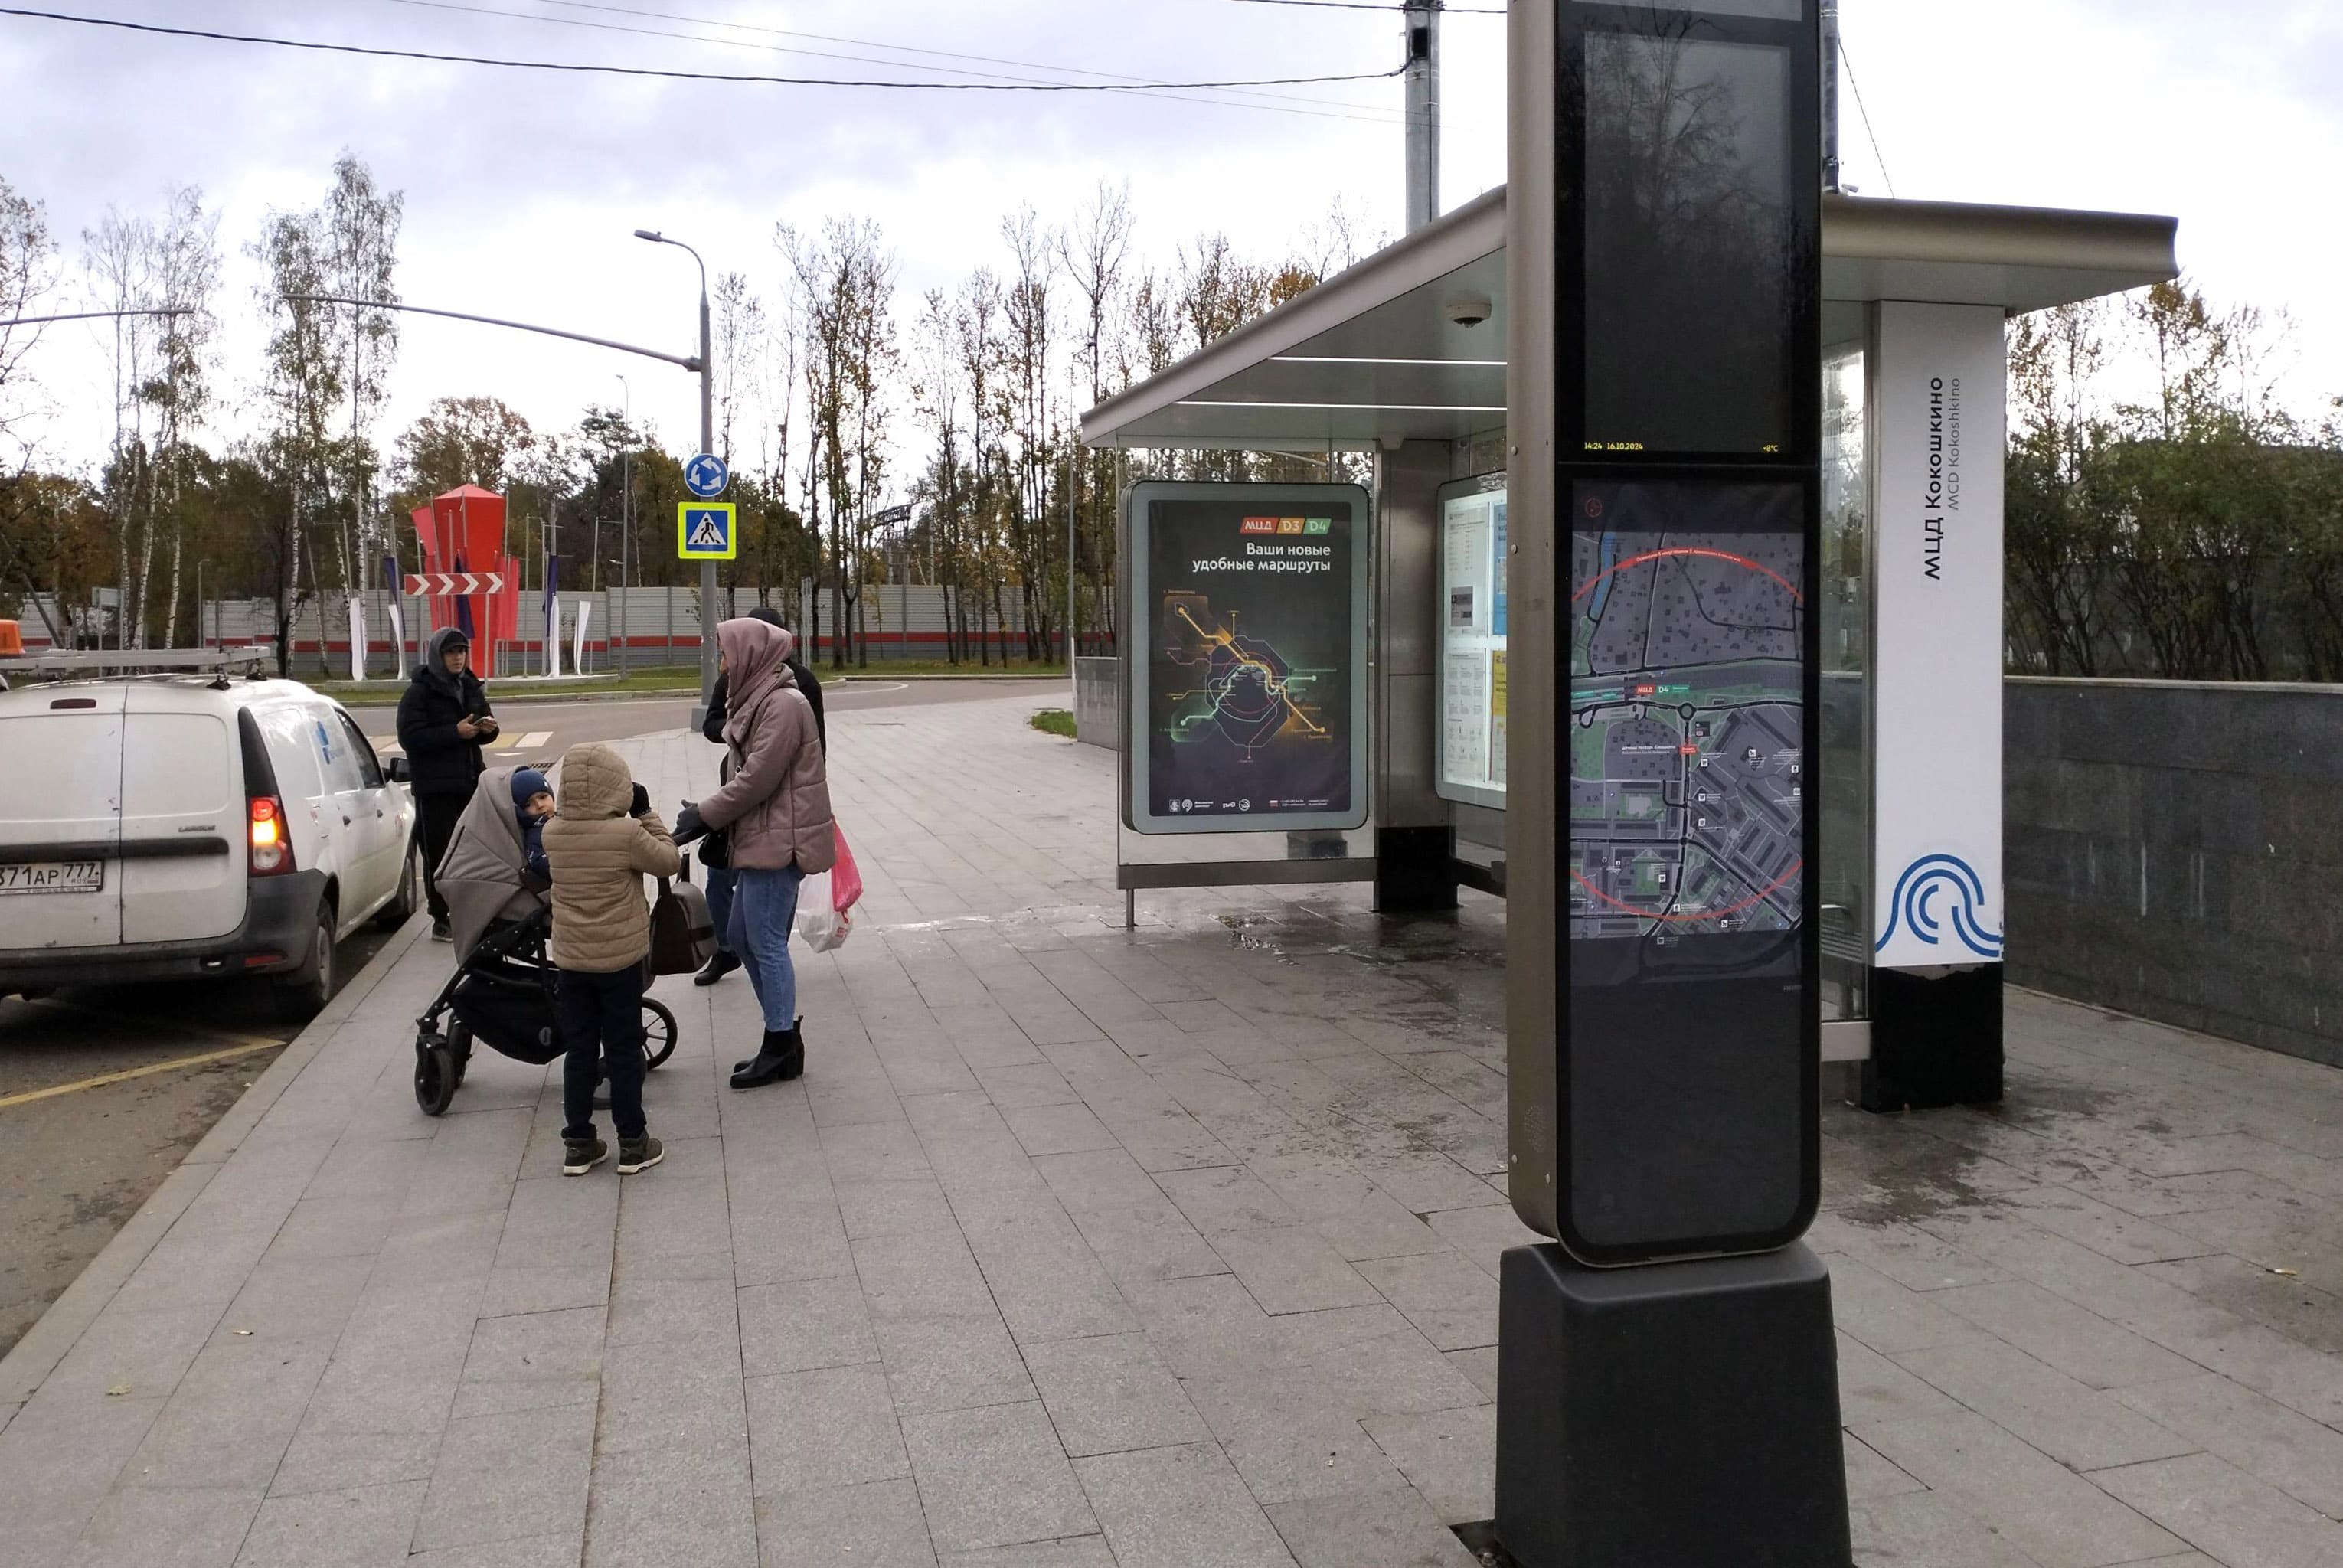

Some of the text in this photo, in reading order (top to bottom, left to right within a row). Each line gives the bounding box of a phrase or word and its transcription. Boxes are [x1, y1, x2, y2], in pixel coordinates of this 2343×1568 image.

[1584, 442, 1603, 450] 14:24
[1947, 377, 1960, 511] MCD Kokoshkino
[1924, 377, 1944, 580] МЦД Кокошкино
[1244, 521, 1327, 531] МЦД D3 D4
[1246, 542, 1331, 556] Ваши новые
[1192, 557, 1331, 573] удобные маршруты
[64, 863, 96, 878] 777
